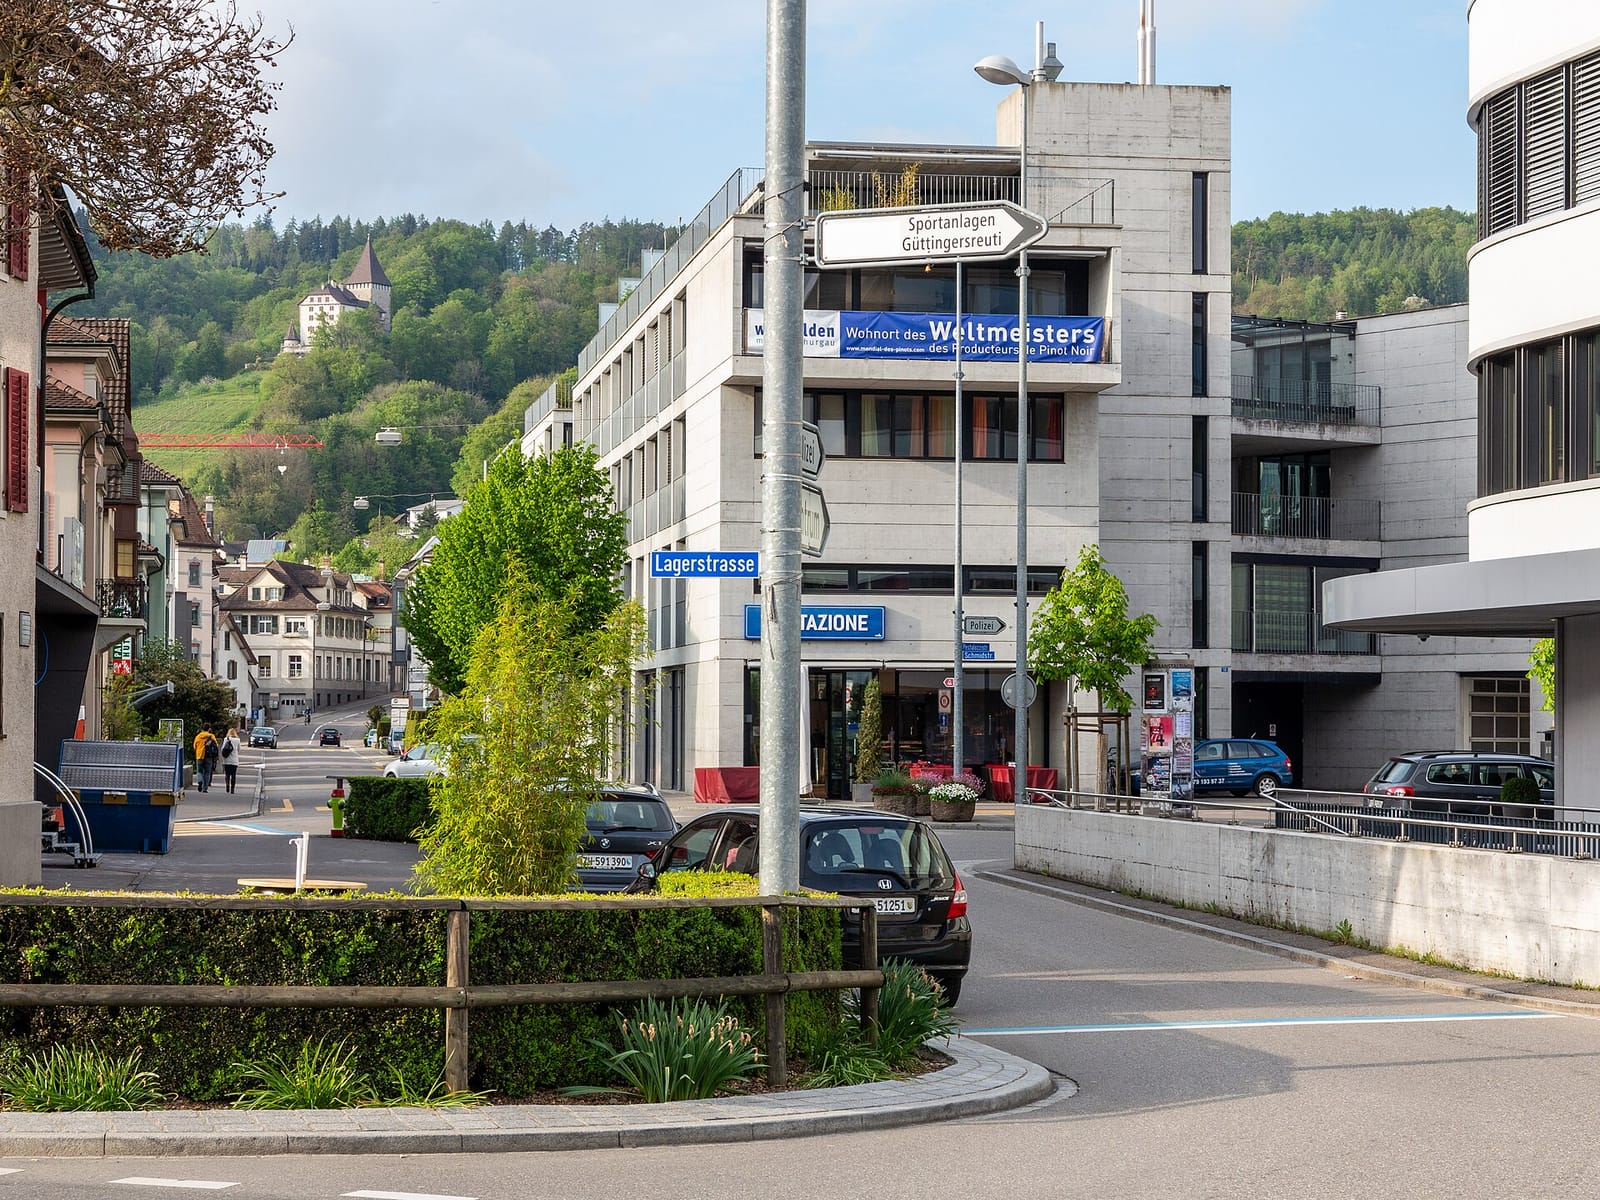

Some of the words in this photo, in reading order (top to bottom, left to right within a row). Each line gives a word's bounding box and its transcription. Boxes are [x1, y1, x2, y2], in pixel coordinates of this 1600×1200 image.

[908, 213, 995, 235] Sportanlagen
[902, 231, 1002, 253] Güttingersreuti
[845, 327, 900, 340] Wohnort
[903, 328, 927, 341] des
[929, 320, 1096, 344] Weltmeisters
[929, 343, 949, 353] des
[1039, 345, 1068, 356] Pinot
[1071, 346, 1094, 358] Noir
[655, 554, 755, 577] Lagerstrasse
[800, 613, 869, 632] TAZIONE
[970, 620, 994, 631] Polizei
